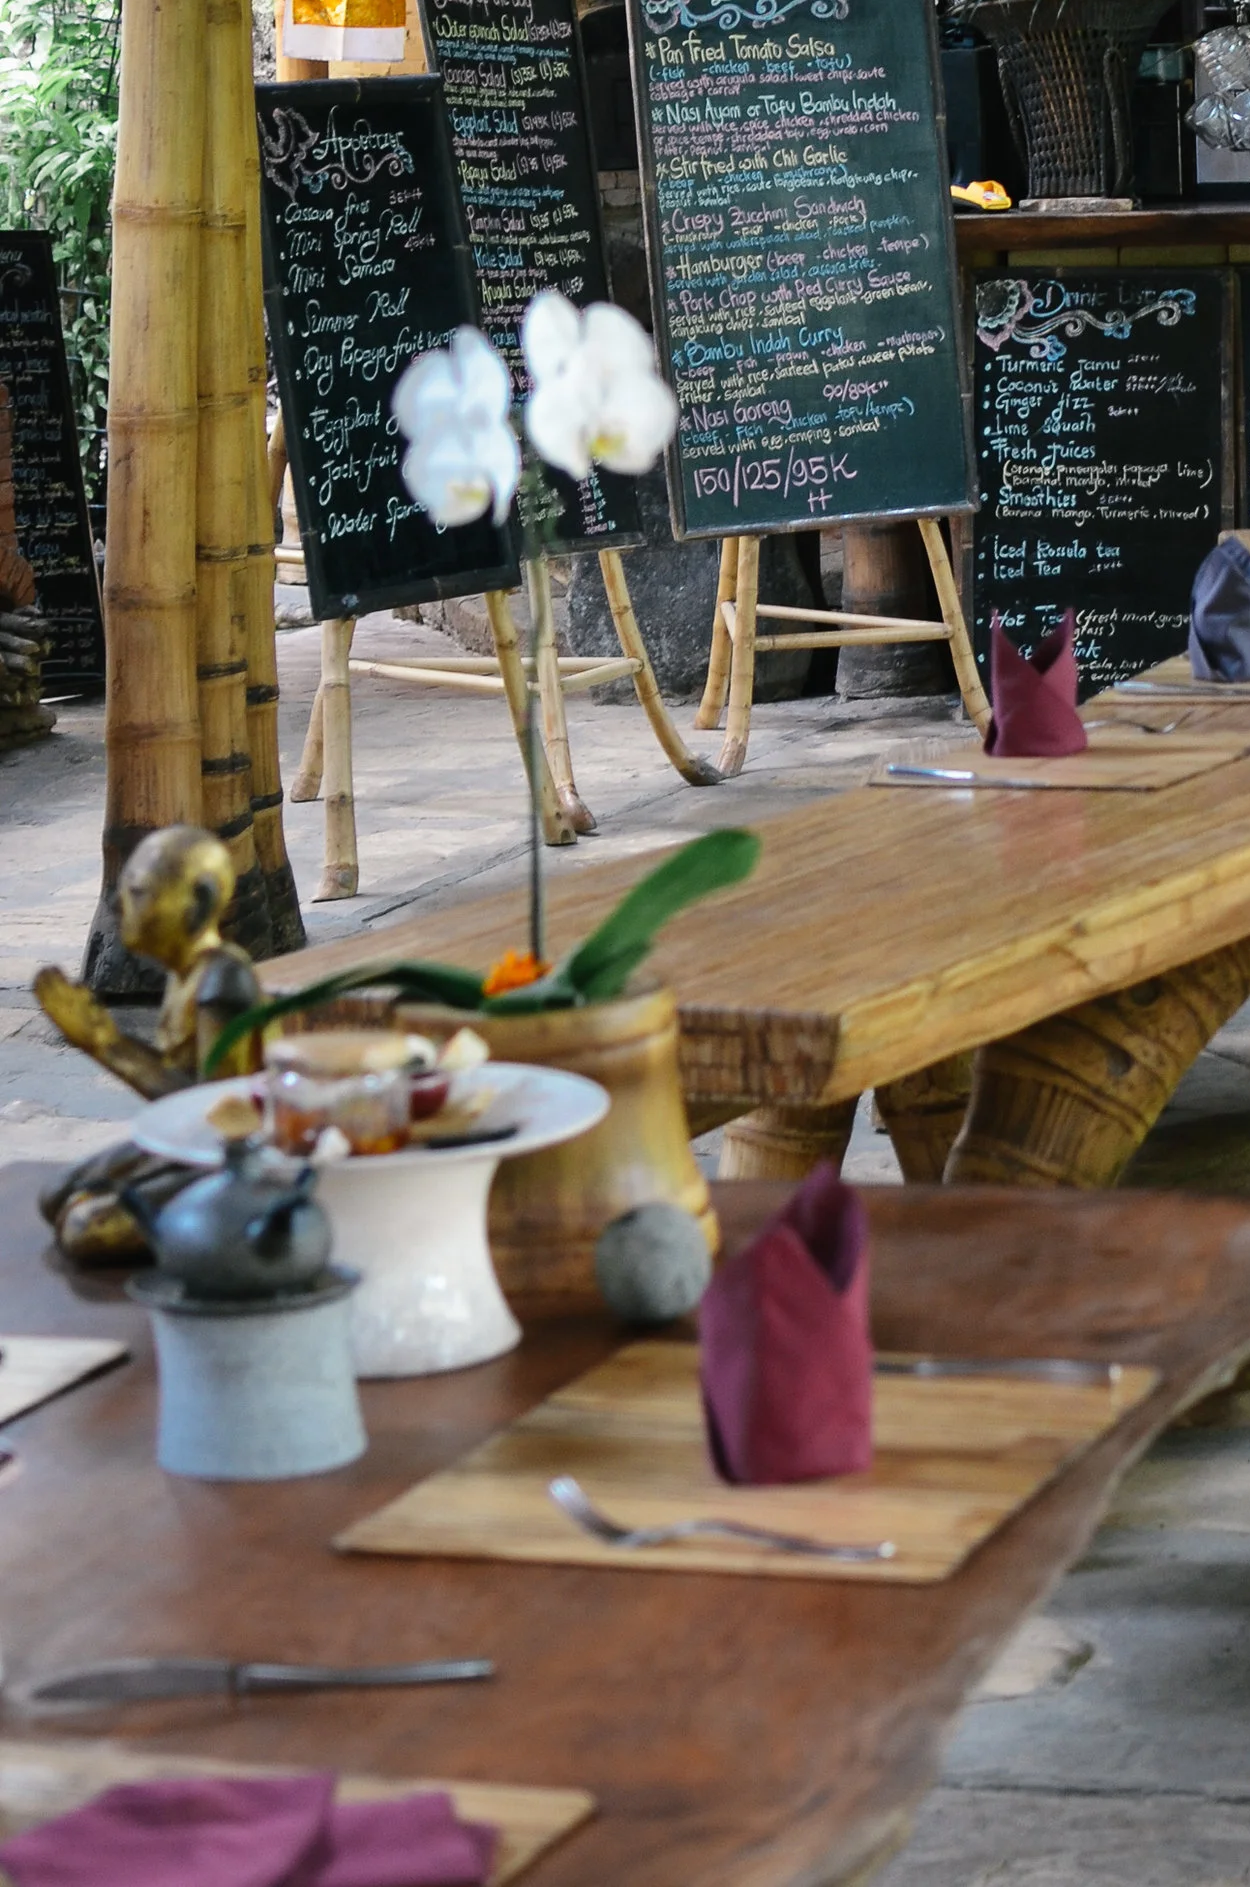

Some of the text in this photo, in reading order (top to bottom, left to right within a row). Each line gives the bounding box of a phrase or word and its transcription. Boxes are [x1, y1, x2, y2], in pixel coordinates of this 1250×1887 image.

[501, 15, 529, 42] Salad
[658, 36, 684, 66] Pan
[728, 34, 782, 61] Tomato
[786, 33, 836, 58] Salsa
[478, 62, 507, 88] Salad
[665, 102, 702, 126] Nasi
[704, 97, 741, 127] Ayam
[746, 105, 761, 118] or
[799, 91, 850, 115] Bambu
[852, 89, 896, 111] Indah
[875, 107, 920, 122] chicken
[492, 110, 519, 134] Salad
[490, 159, 517, 182] Salad
[670, 154, 700, 180] Stir
[738, 152, 769, 170] with
[803, 143, 849, 167] Garlic
[284, 202, 334, 225] Cassava
[501, 208, 527, 233] Salad
[671, 195, 867, 234] Crispy Zucchini Sandwich
[286, 228, 322, 260] Mini
[497, 245, 524, 269] Salad
[287, 253, 396, 294] Mini Samosa
[675, 251, 763, 281] Hamburger
[514, 276, 538, 298] Salad
[680, 288, 715, 316] Pork
[761, 282, 793, 304] with
[794, 278, 823, 299] Red
[867, 268, 912, 289] Sauce
[300, 287, 412, 339] Summer Roll
[683, 325, 844, 368] Bambu Indah Curry
[303, 345, 335, 397] Dry
[339, 336, 387, 382] Papaya
[995, 354, 1066, 374] Turmeric
[996, 376, 1059, 394] Coconut
[691, 398, 794, 432] Nasi Goreng
[995, 393, 1043, 420] Ginger
[309, 396, 381, 456] Eggplant
[990, 413, 1029, 436] Lime
[990, 437, 1038, 463] Fresh
[357, 443, 399, 493] fruit
[998, 485, 1078, 507] Smoothies
[327, 508, 378, 540] Water
[1033, 560, 1062, 577] Tea
